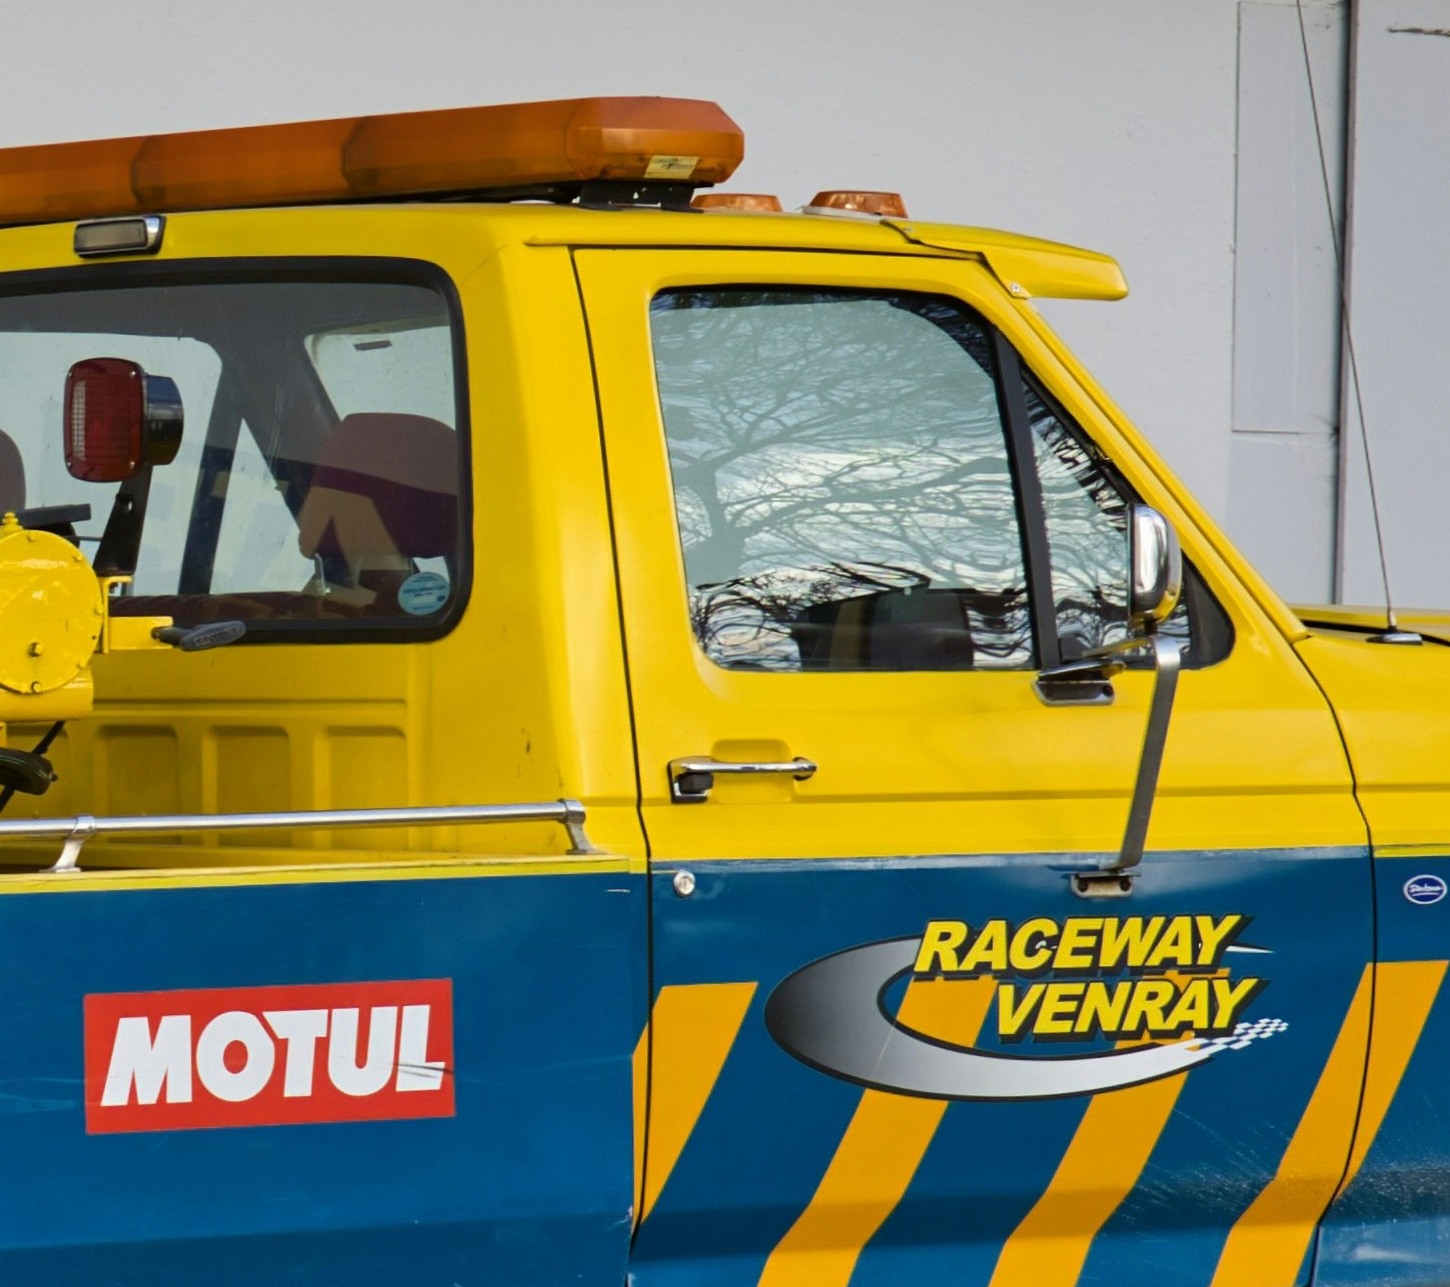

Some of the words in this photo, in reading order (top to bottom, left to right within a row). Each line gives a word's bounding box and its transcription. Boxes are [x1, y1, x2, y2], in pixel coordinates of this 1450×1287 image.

[913, 915, 1242, 972] RACEWAY
[997, 977, 1258, 1035] VENRAY
[100, 1004, 445, 1107] MOTUL
